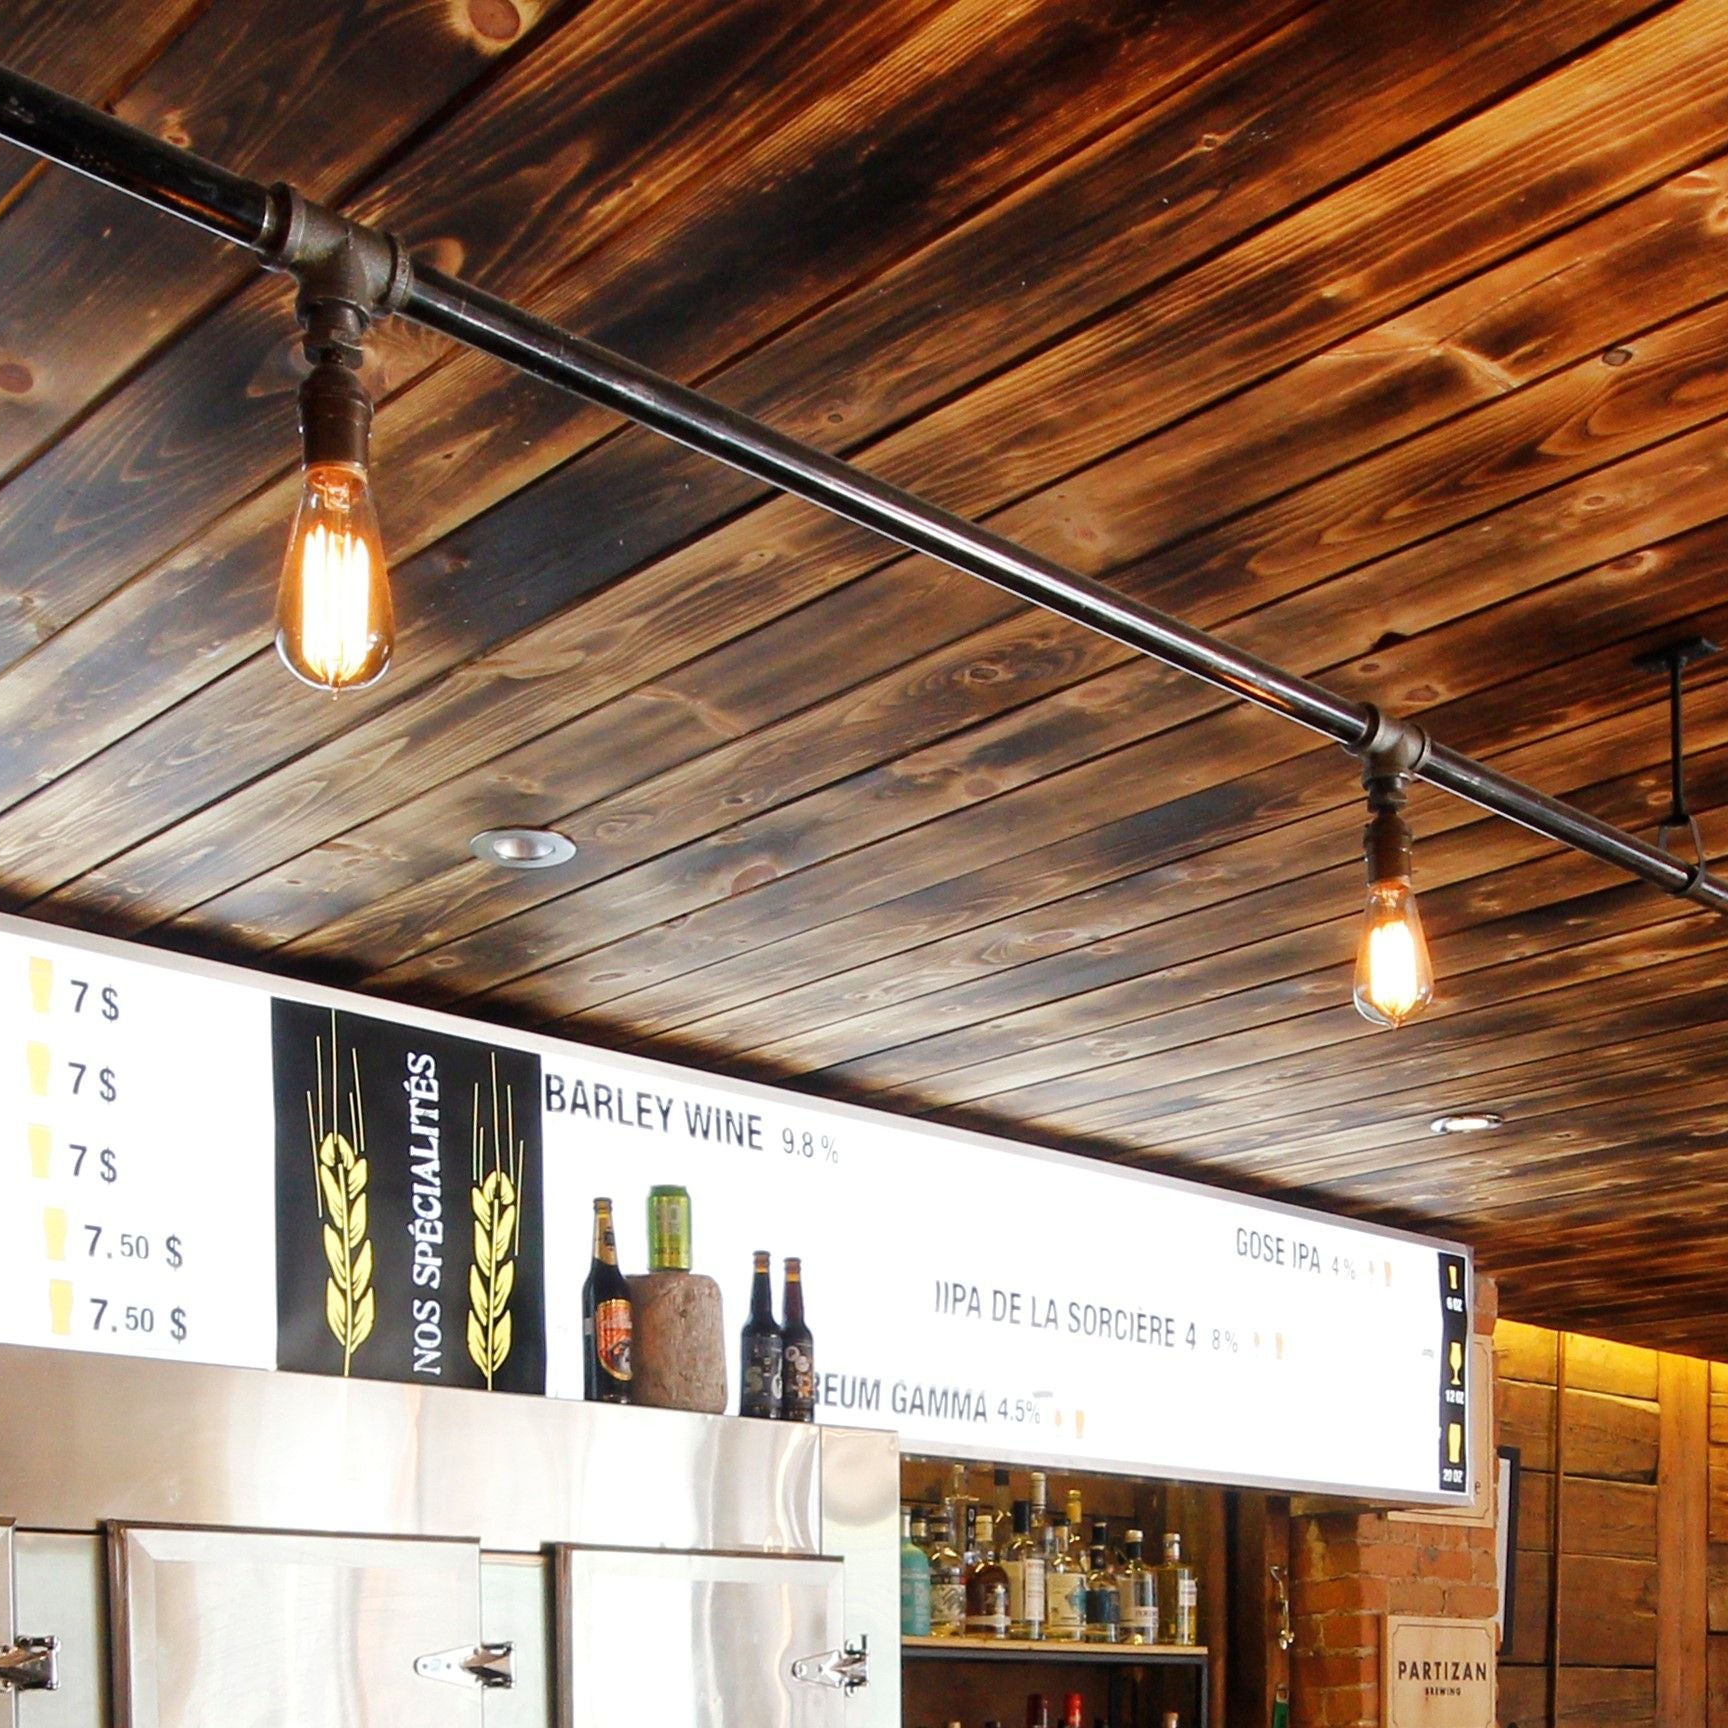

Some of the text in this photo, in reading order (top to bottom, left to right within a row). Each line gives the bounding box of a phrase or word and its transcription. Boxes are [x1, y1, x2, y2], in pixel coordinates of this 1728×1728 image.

[70, 979, 89, 1013] 7
[68, 1061, 87, 1095] 7
[545, 1072, 674, 1134] BARLEY
[684, 1100, 764, 1152] WINE
[781, 1127, 815, 1159] 9.8
[69, 1143, 88, 1177] 7
[403, 1052, 444, 1376] NOS SPÉCIALITÉS
[84, 1224, 149, 1259] 7.50
[1235, 1226, 1286, 1267] GOSE
[1291, 1240, 1321, 1275] IPA
[89, 1297, 154, 1333] 7.50
[991, 1288, 1022, 1325] DE
[1030, 1295, 1059, 1331] LA
[891, 1381, 988, 1424] GAMMA
[1397, 1660, 1488, 1681] PARTIZAN
